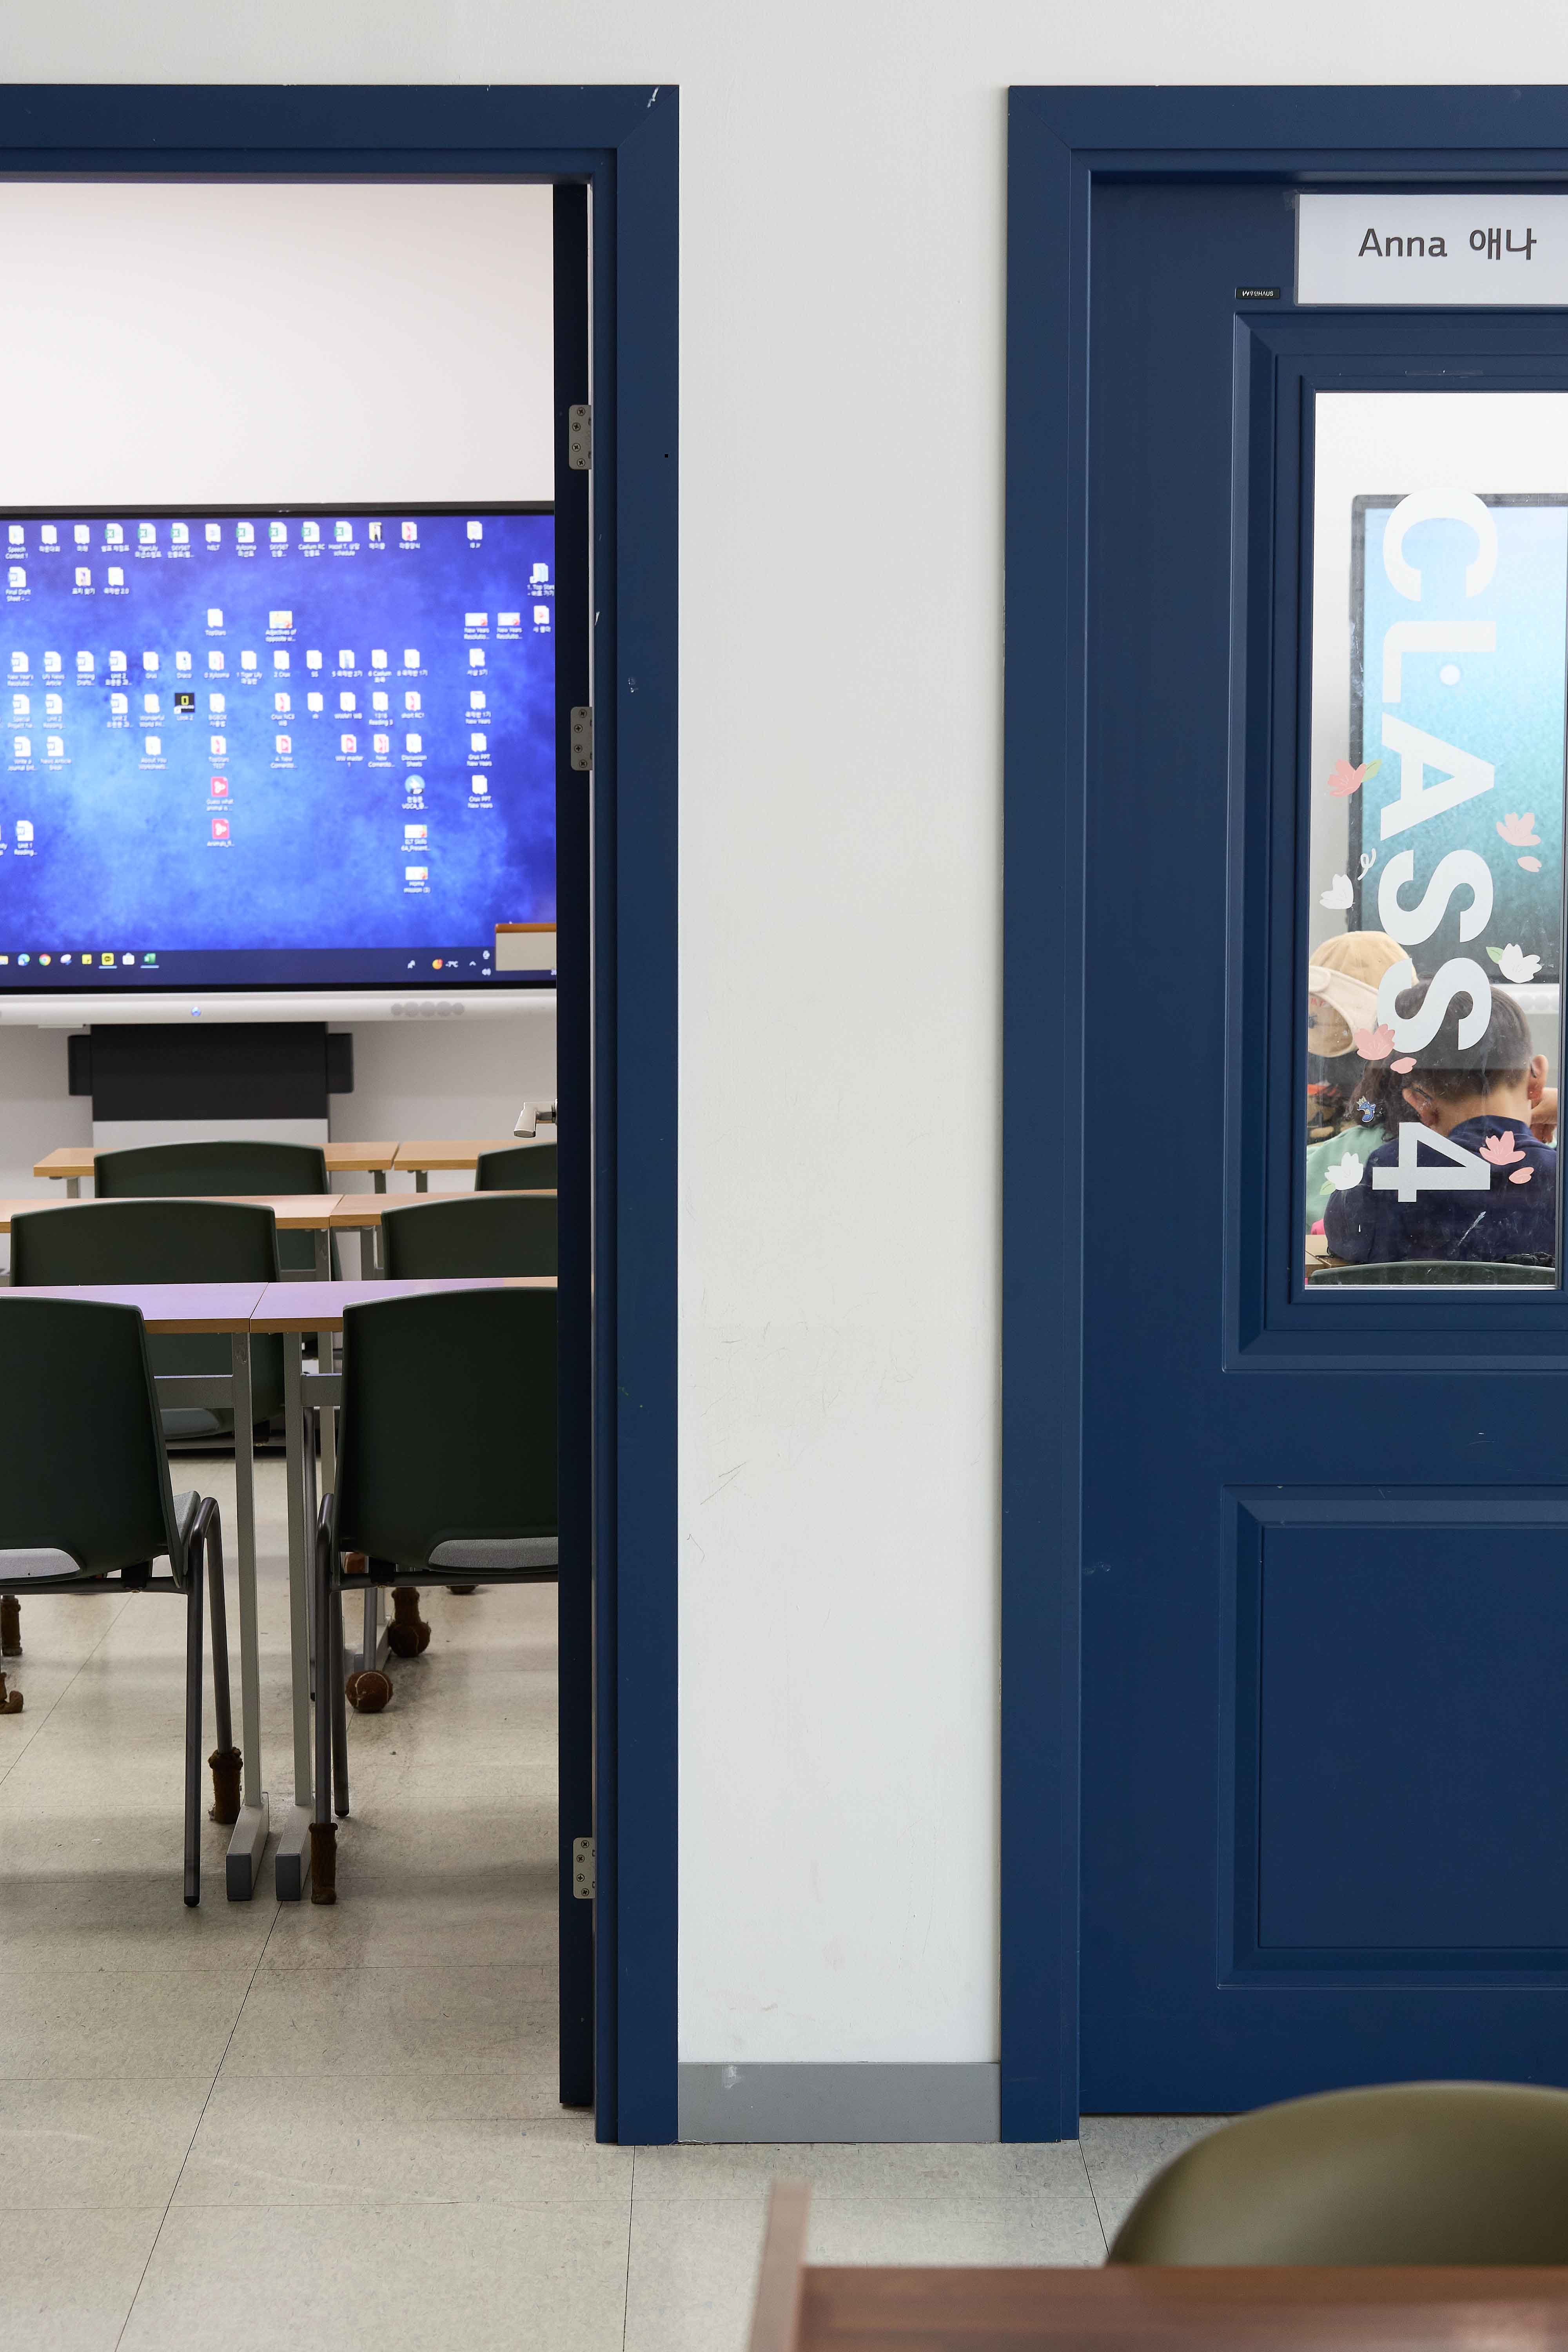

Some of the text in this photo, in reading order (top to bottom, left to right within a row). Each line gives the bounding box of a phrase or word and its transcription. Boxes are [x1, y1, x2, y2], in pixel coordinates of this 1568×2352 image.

[1359, 228, 1537, 260] Anna 애나
[1372, 488, 1498, 1202] CLASS 4
